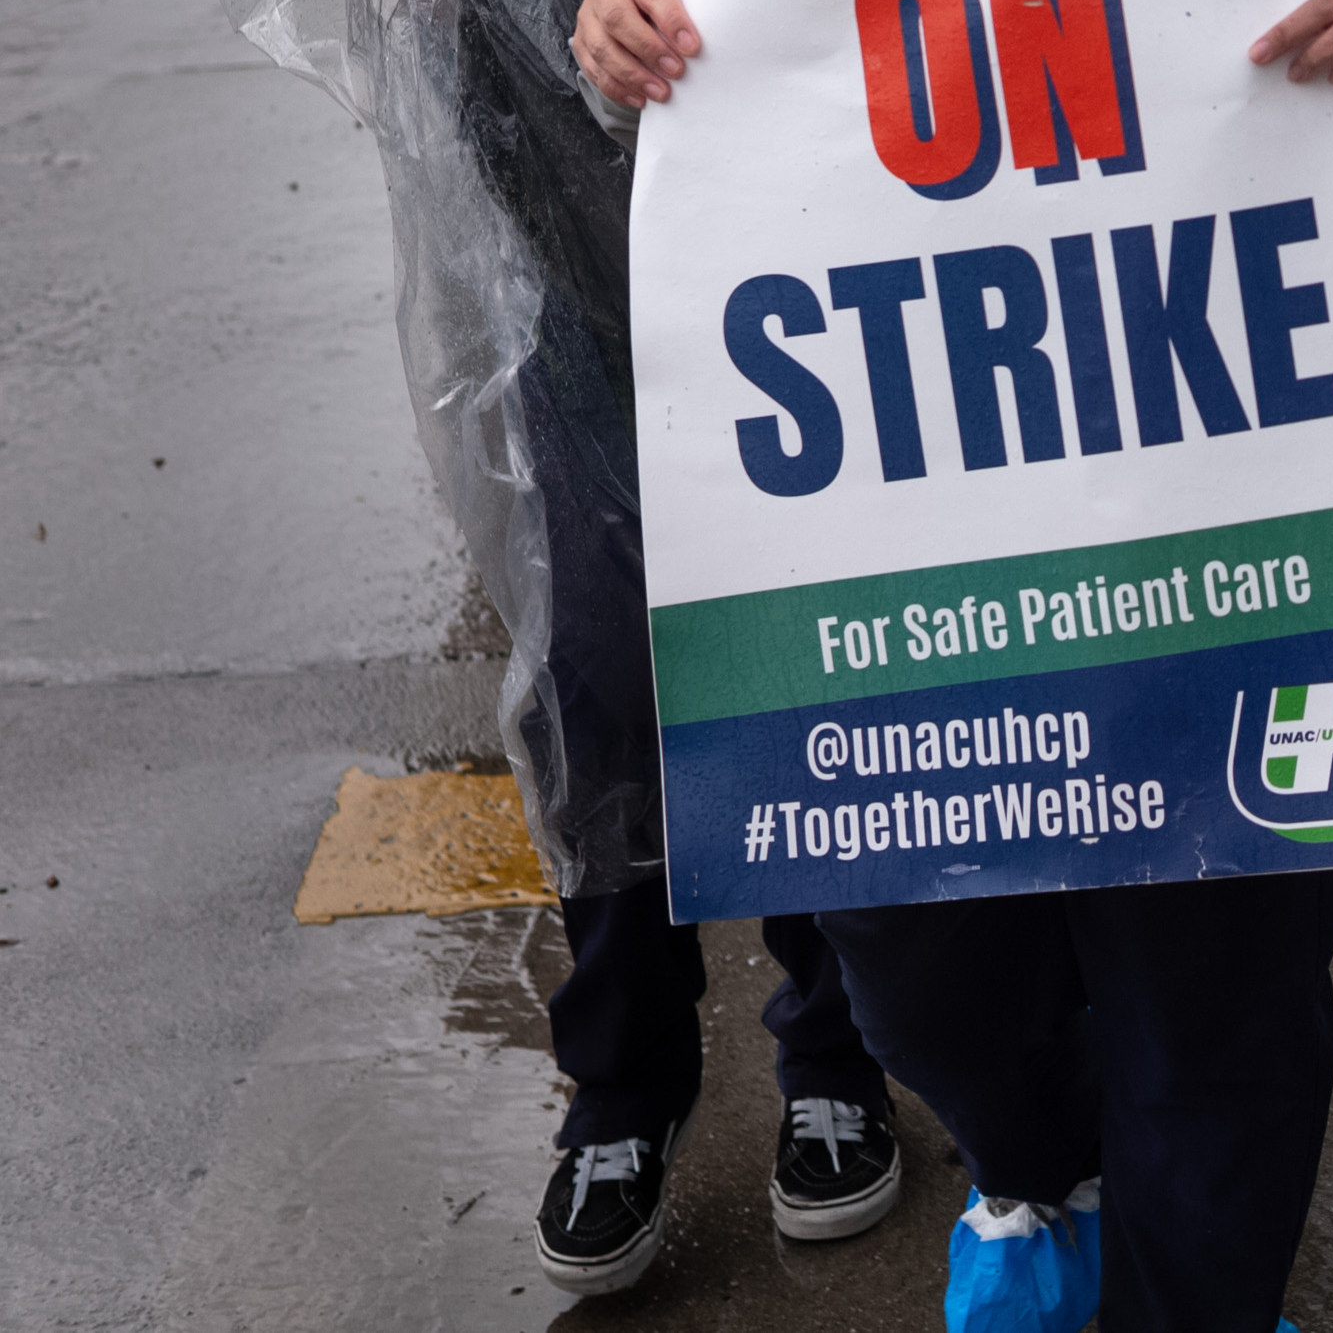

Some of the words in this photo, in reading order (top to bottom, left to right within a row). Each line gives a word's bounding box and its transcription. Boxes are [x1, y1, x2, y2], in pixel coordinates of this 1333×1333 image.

[818, 615, 890, 674] For
[903, 596, 1008, 661] Safe
[1019, 566, 1194, 645] Patient
[1202, 554, 1312, 617] Care
[806, 707, 1090, 780] @unacuhcp
[744, 774, 1166, 862] #TogetherWeRise
